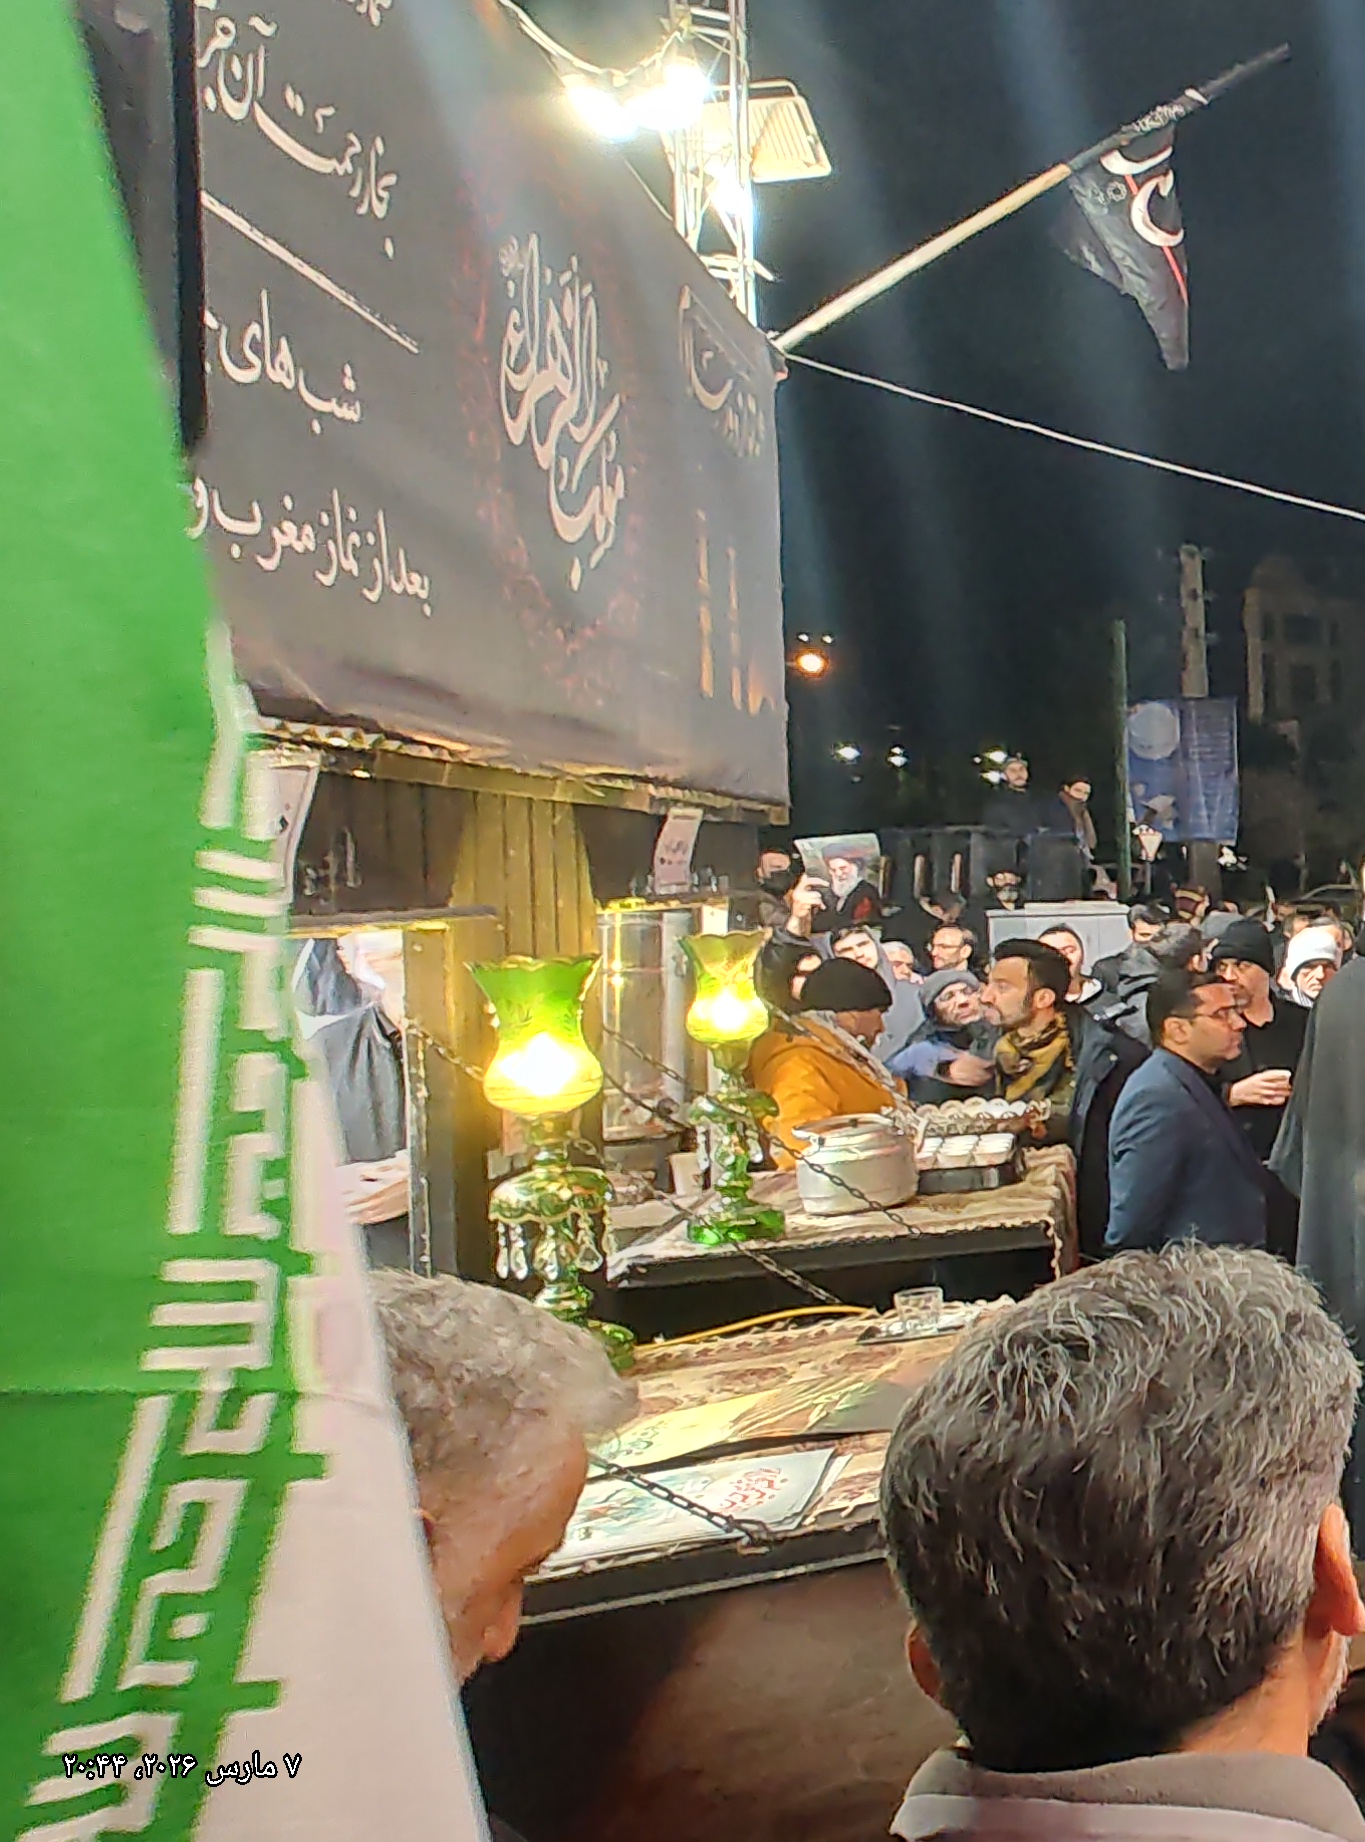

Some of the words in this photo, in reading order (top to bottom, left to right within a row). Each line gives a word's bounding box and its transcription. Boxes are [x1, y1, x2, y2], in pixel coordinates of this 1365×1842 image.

[209, 488, 317, 572] مغرب
[314, 487, 363, 588] نماز
[361, 508, 390, 604] از
